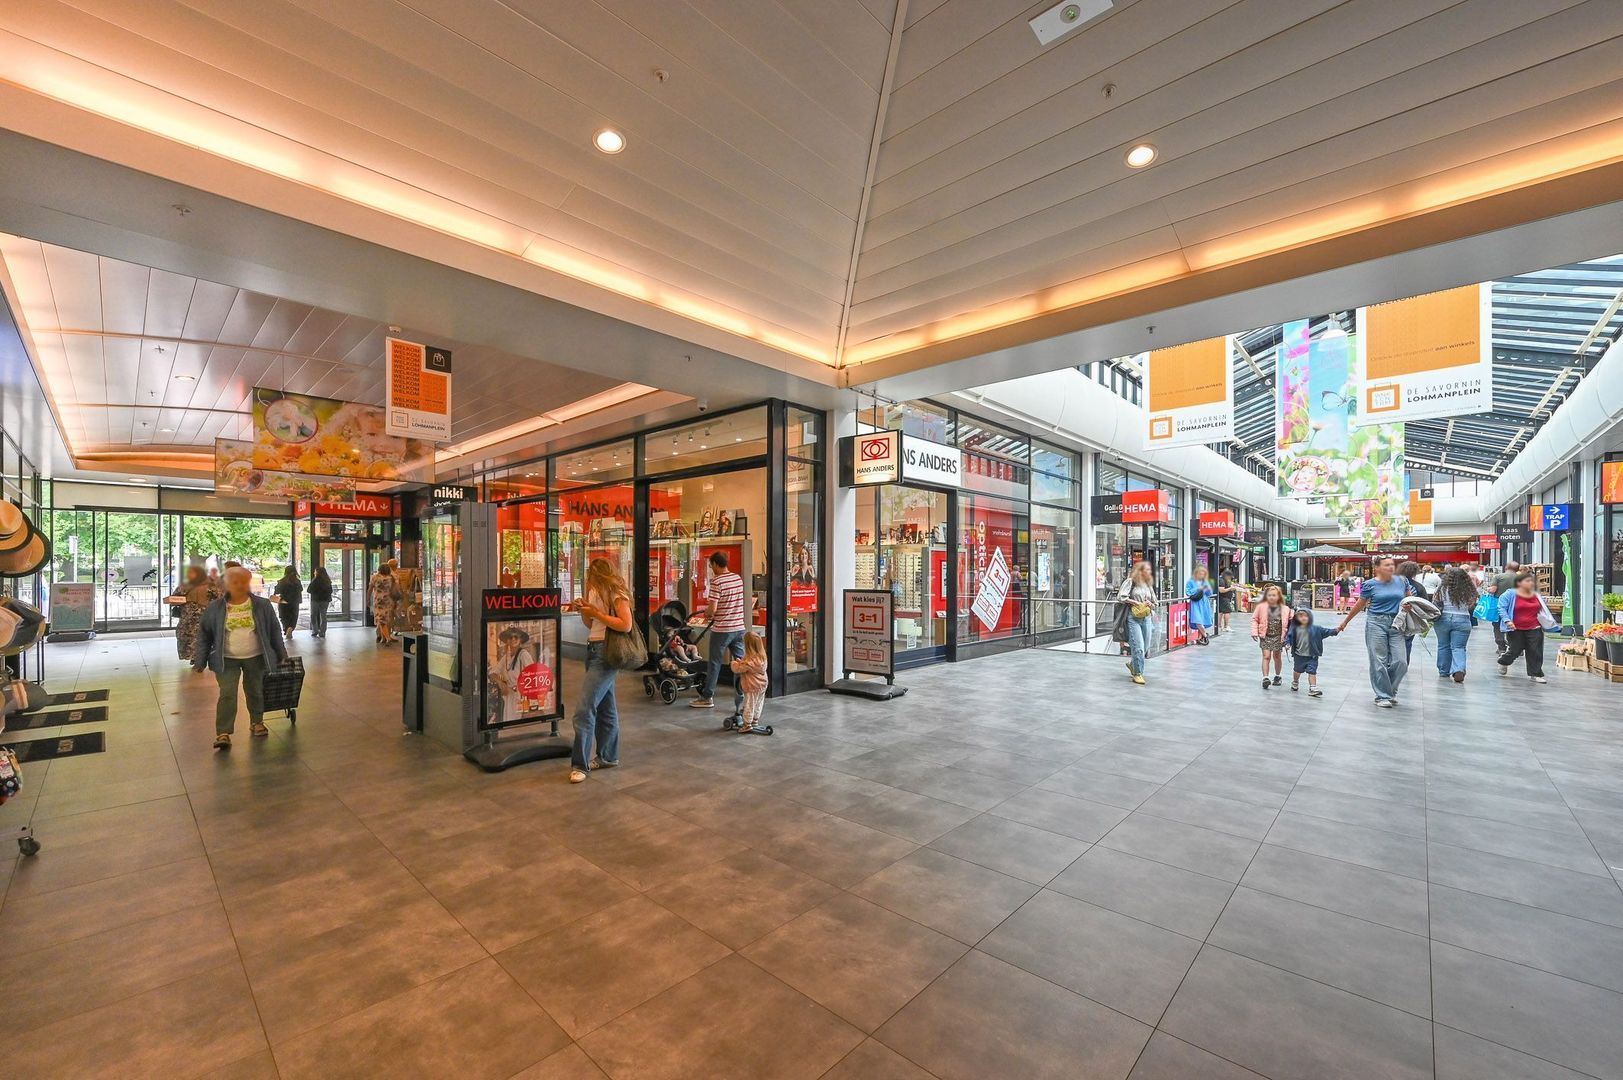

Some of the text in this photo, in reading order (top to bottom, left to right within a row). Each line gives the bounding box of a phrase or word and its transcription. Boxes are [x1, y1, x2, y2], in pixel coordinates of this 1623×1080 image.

[1407, 379, 1481, 396] DE SAVORNIN
[1407, 388, 1481, 402] LOHMANPLEIN
[1177, 421, 1227, 432] LOHMANPLEIN
[902, 448, 957, 474] NS ANDERS
[872, 464, 895, 472] ANDERS
[434, 486, 463, 499] nikki
[568, 500, 609, 518] HANS
[1124, 503, 1156, 513] HEMA
[1550, 520, 1560, 528] P
[485, 593, 558, 609] WELKOM
[858, 613, 877, 624] 3=1
[520, 675, 551, 689] -21%
